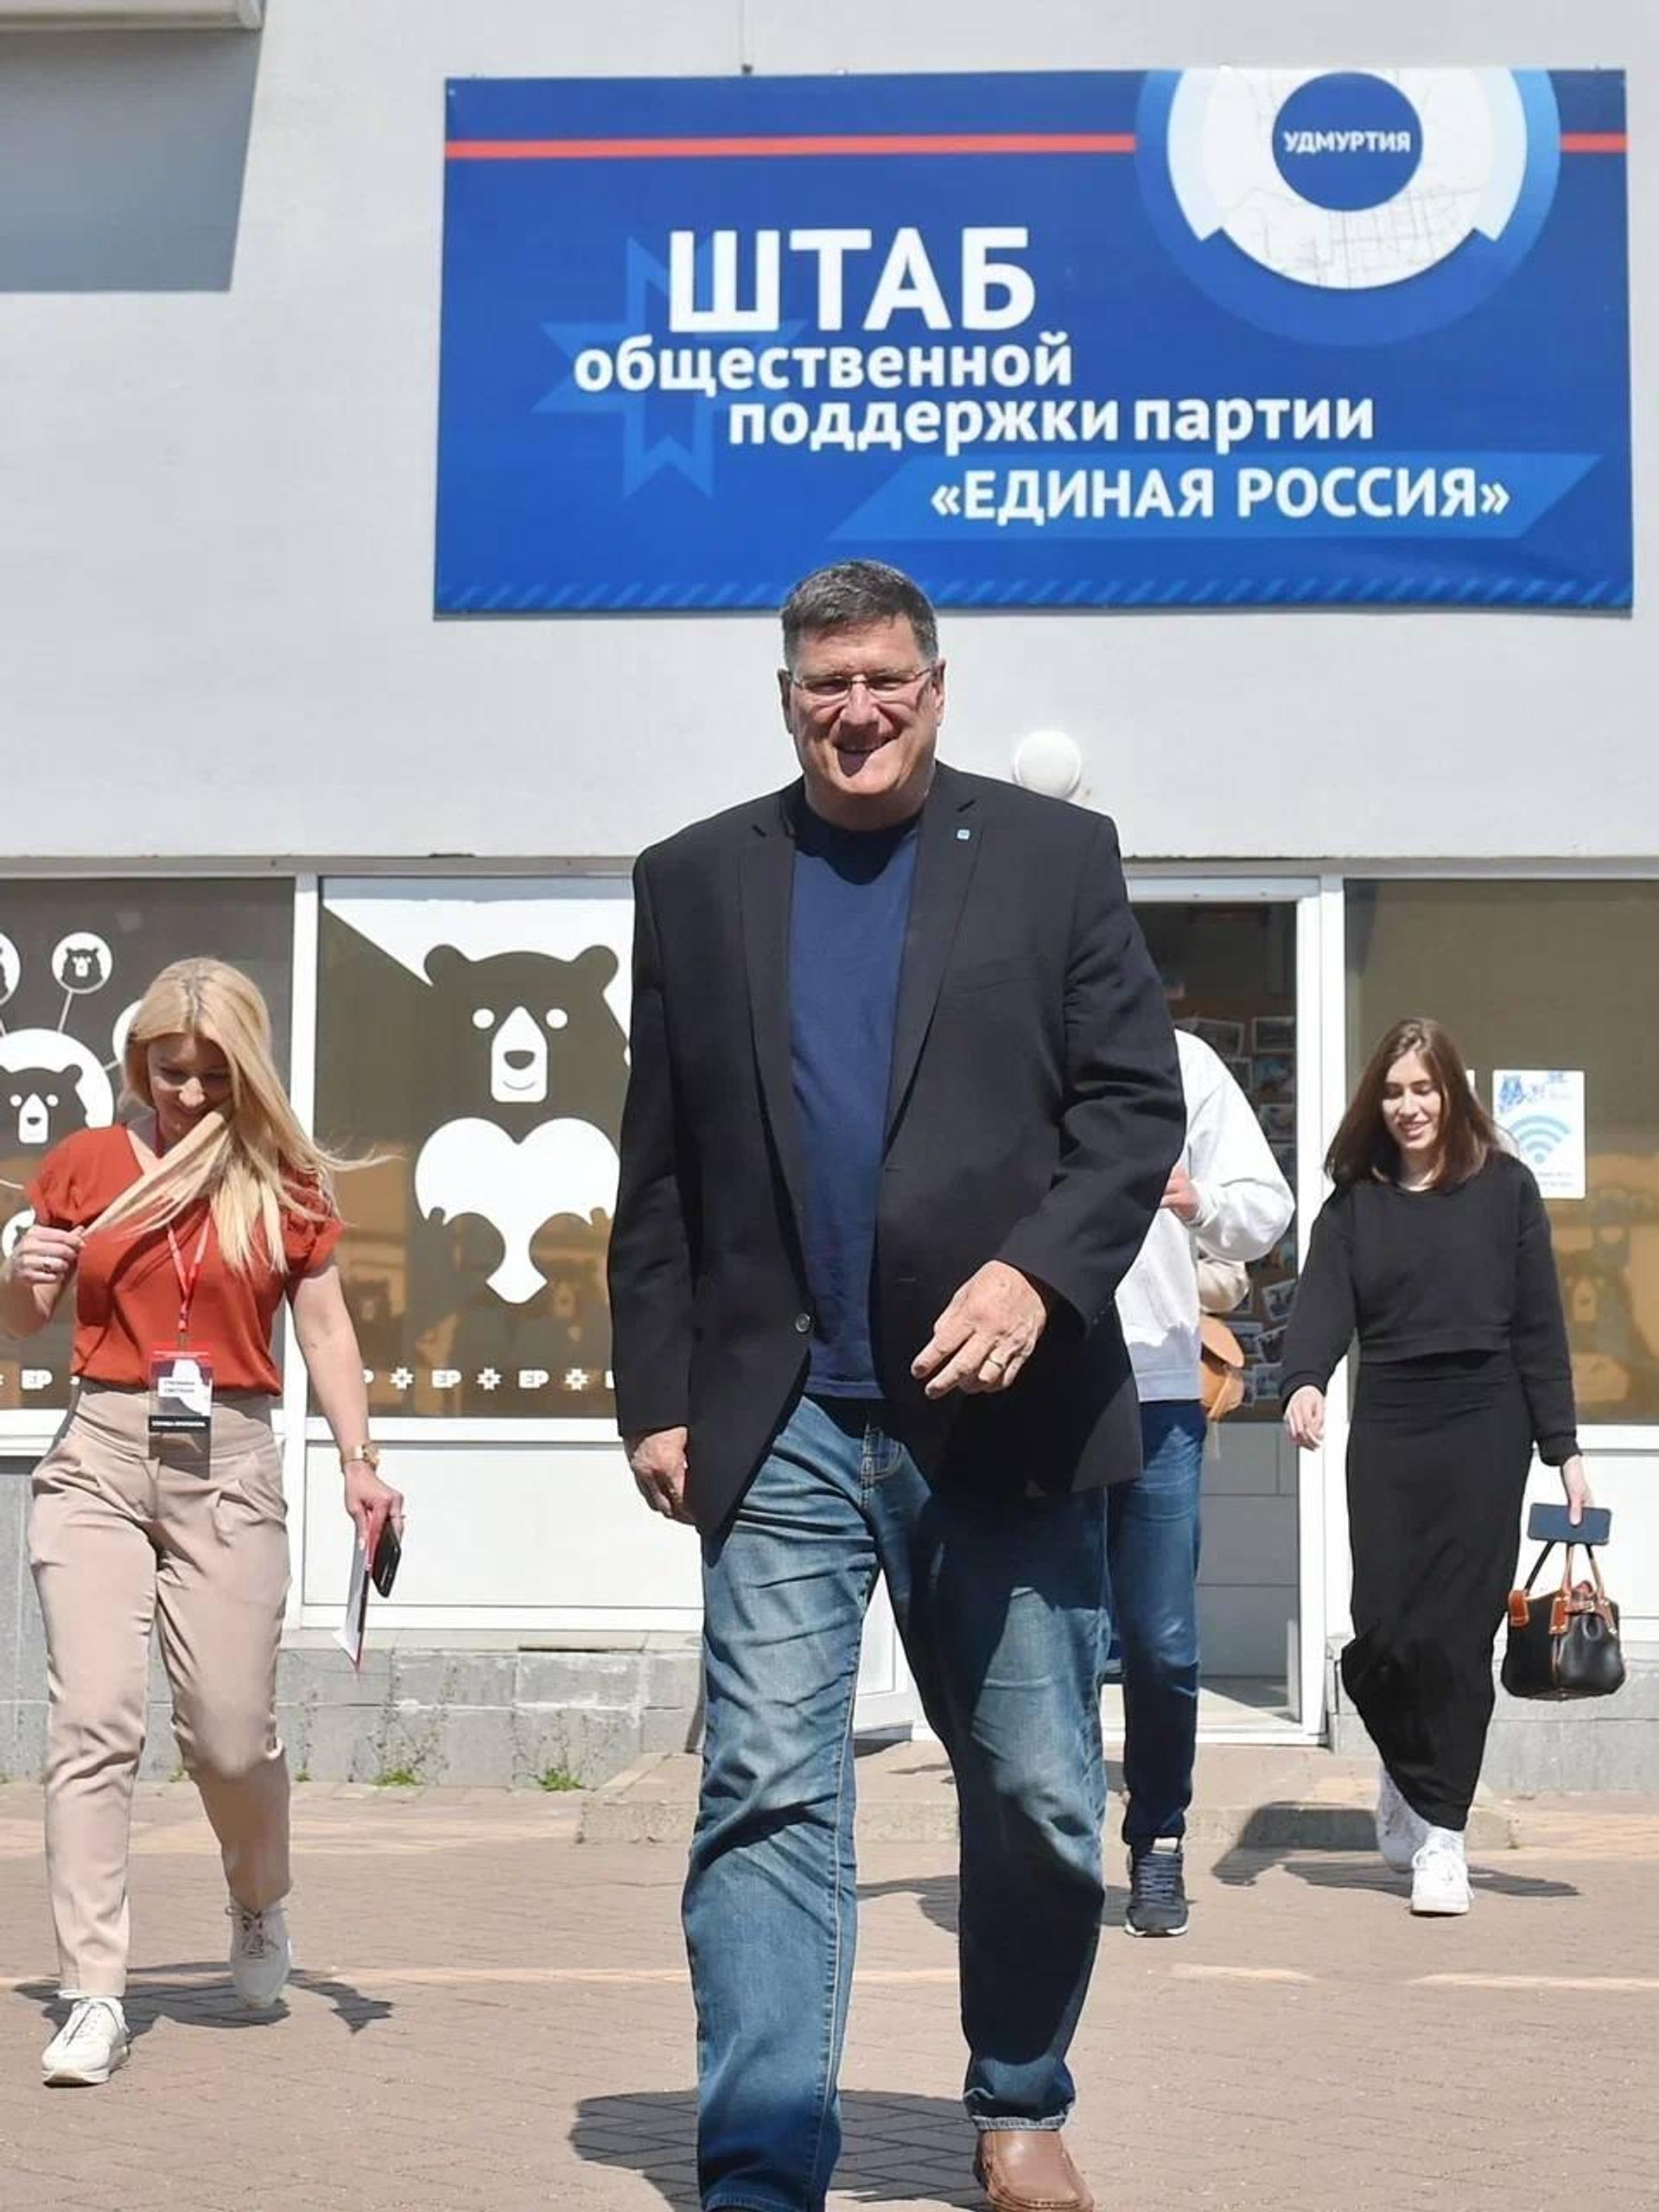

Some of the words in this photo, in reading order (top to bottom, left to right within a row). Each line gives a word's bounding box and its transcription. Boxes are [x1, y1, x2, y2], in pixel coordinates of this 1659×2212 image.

[1284, 131, 1411, 154] УДМУРТИЯ
[669, 227, 1035, 333] ШТАБ
[575, 332, 1071, 397] общественной
[729, 400, 1118, 457] поддержки
[1135, 398, 1373, 454] партии
[931, 468, 1214, 526] «ЕДИНАЯ
[1238, 467, 1510, 518] РОССИЯ»
